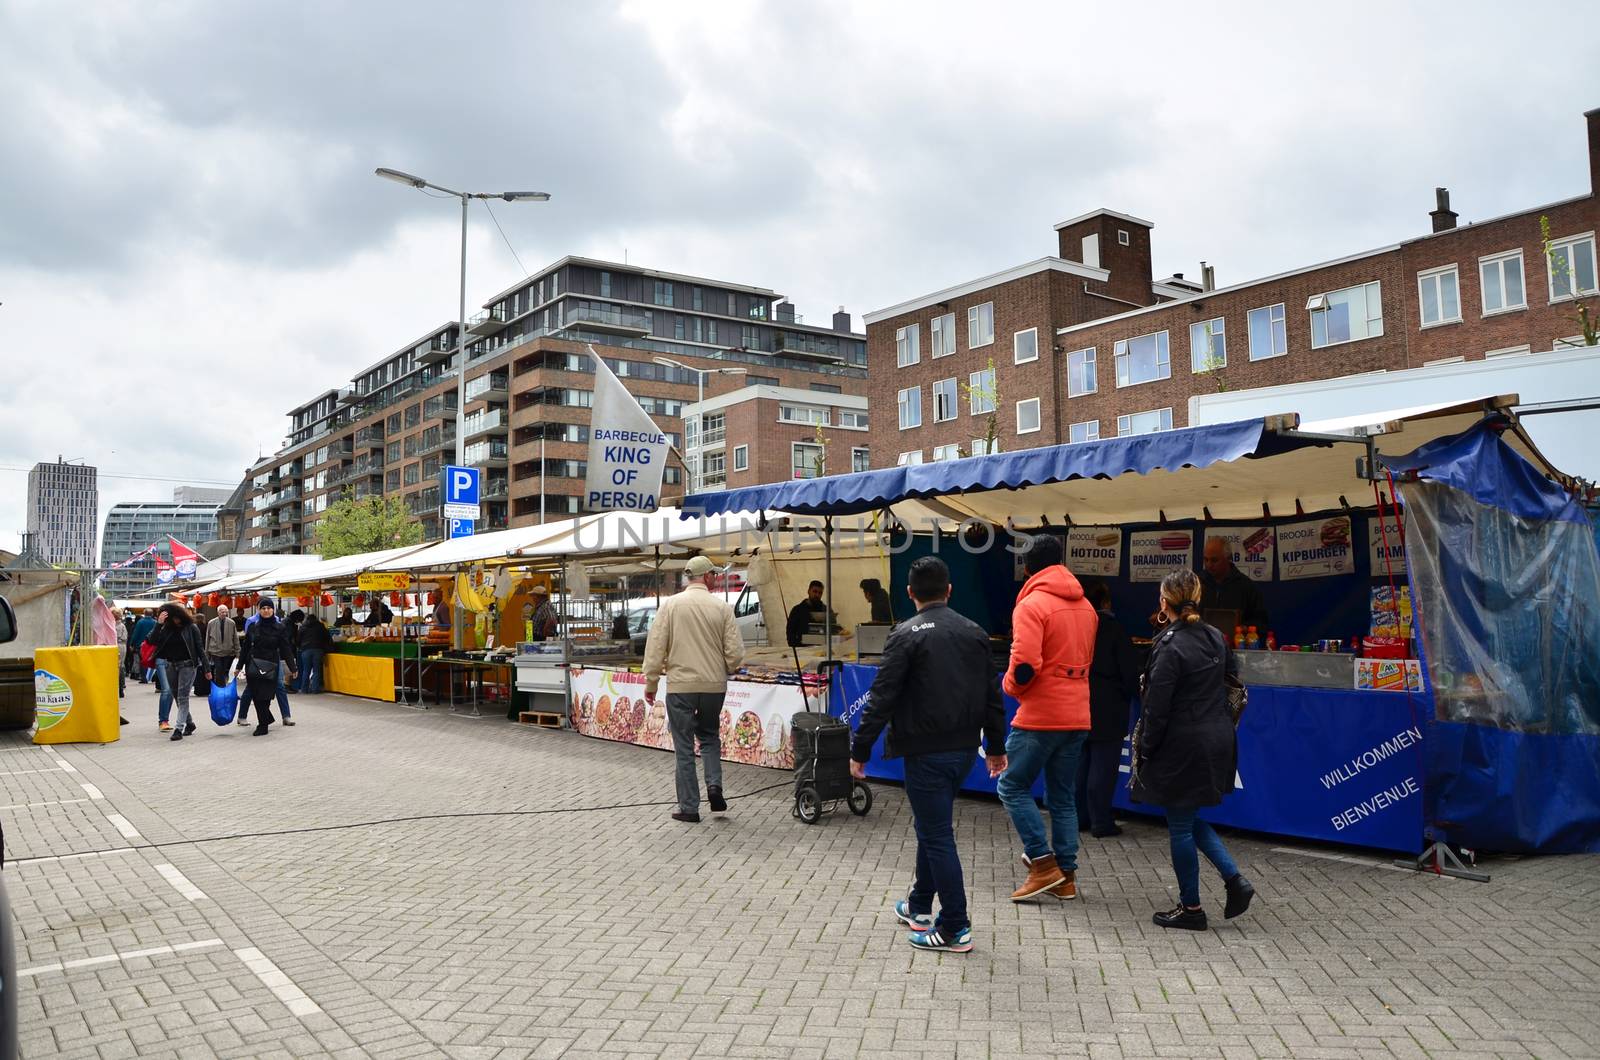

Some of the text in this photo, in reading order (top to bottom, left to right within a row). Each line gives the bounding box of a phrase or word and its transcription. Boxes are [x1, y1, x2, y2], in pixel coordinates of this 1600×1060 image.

[595, 429, 665, 445] BARBECUE
[604, 446, 651, 465] KING
[453, 471, 473, 500] P
[612, 469, 638, 486] OF
[588, 491, 656, 510] PERSIA
[1280, 528, 1316, 541] BROODJE
[1071, 548, 1116, 559] HOTDOG
[1132, 553, 1187, 566] BRAADWORST
[1282, 546, 1347, 563] KIPBURGER
[47, 695, 70, 703] Kaas
[1319, 726, 1423, 790] WILLKOMMEN
[1330, 776, 1420, 831] BIENVENUE
